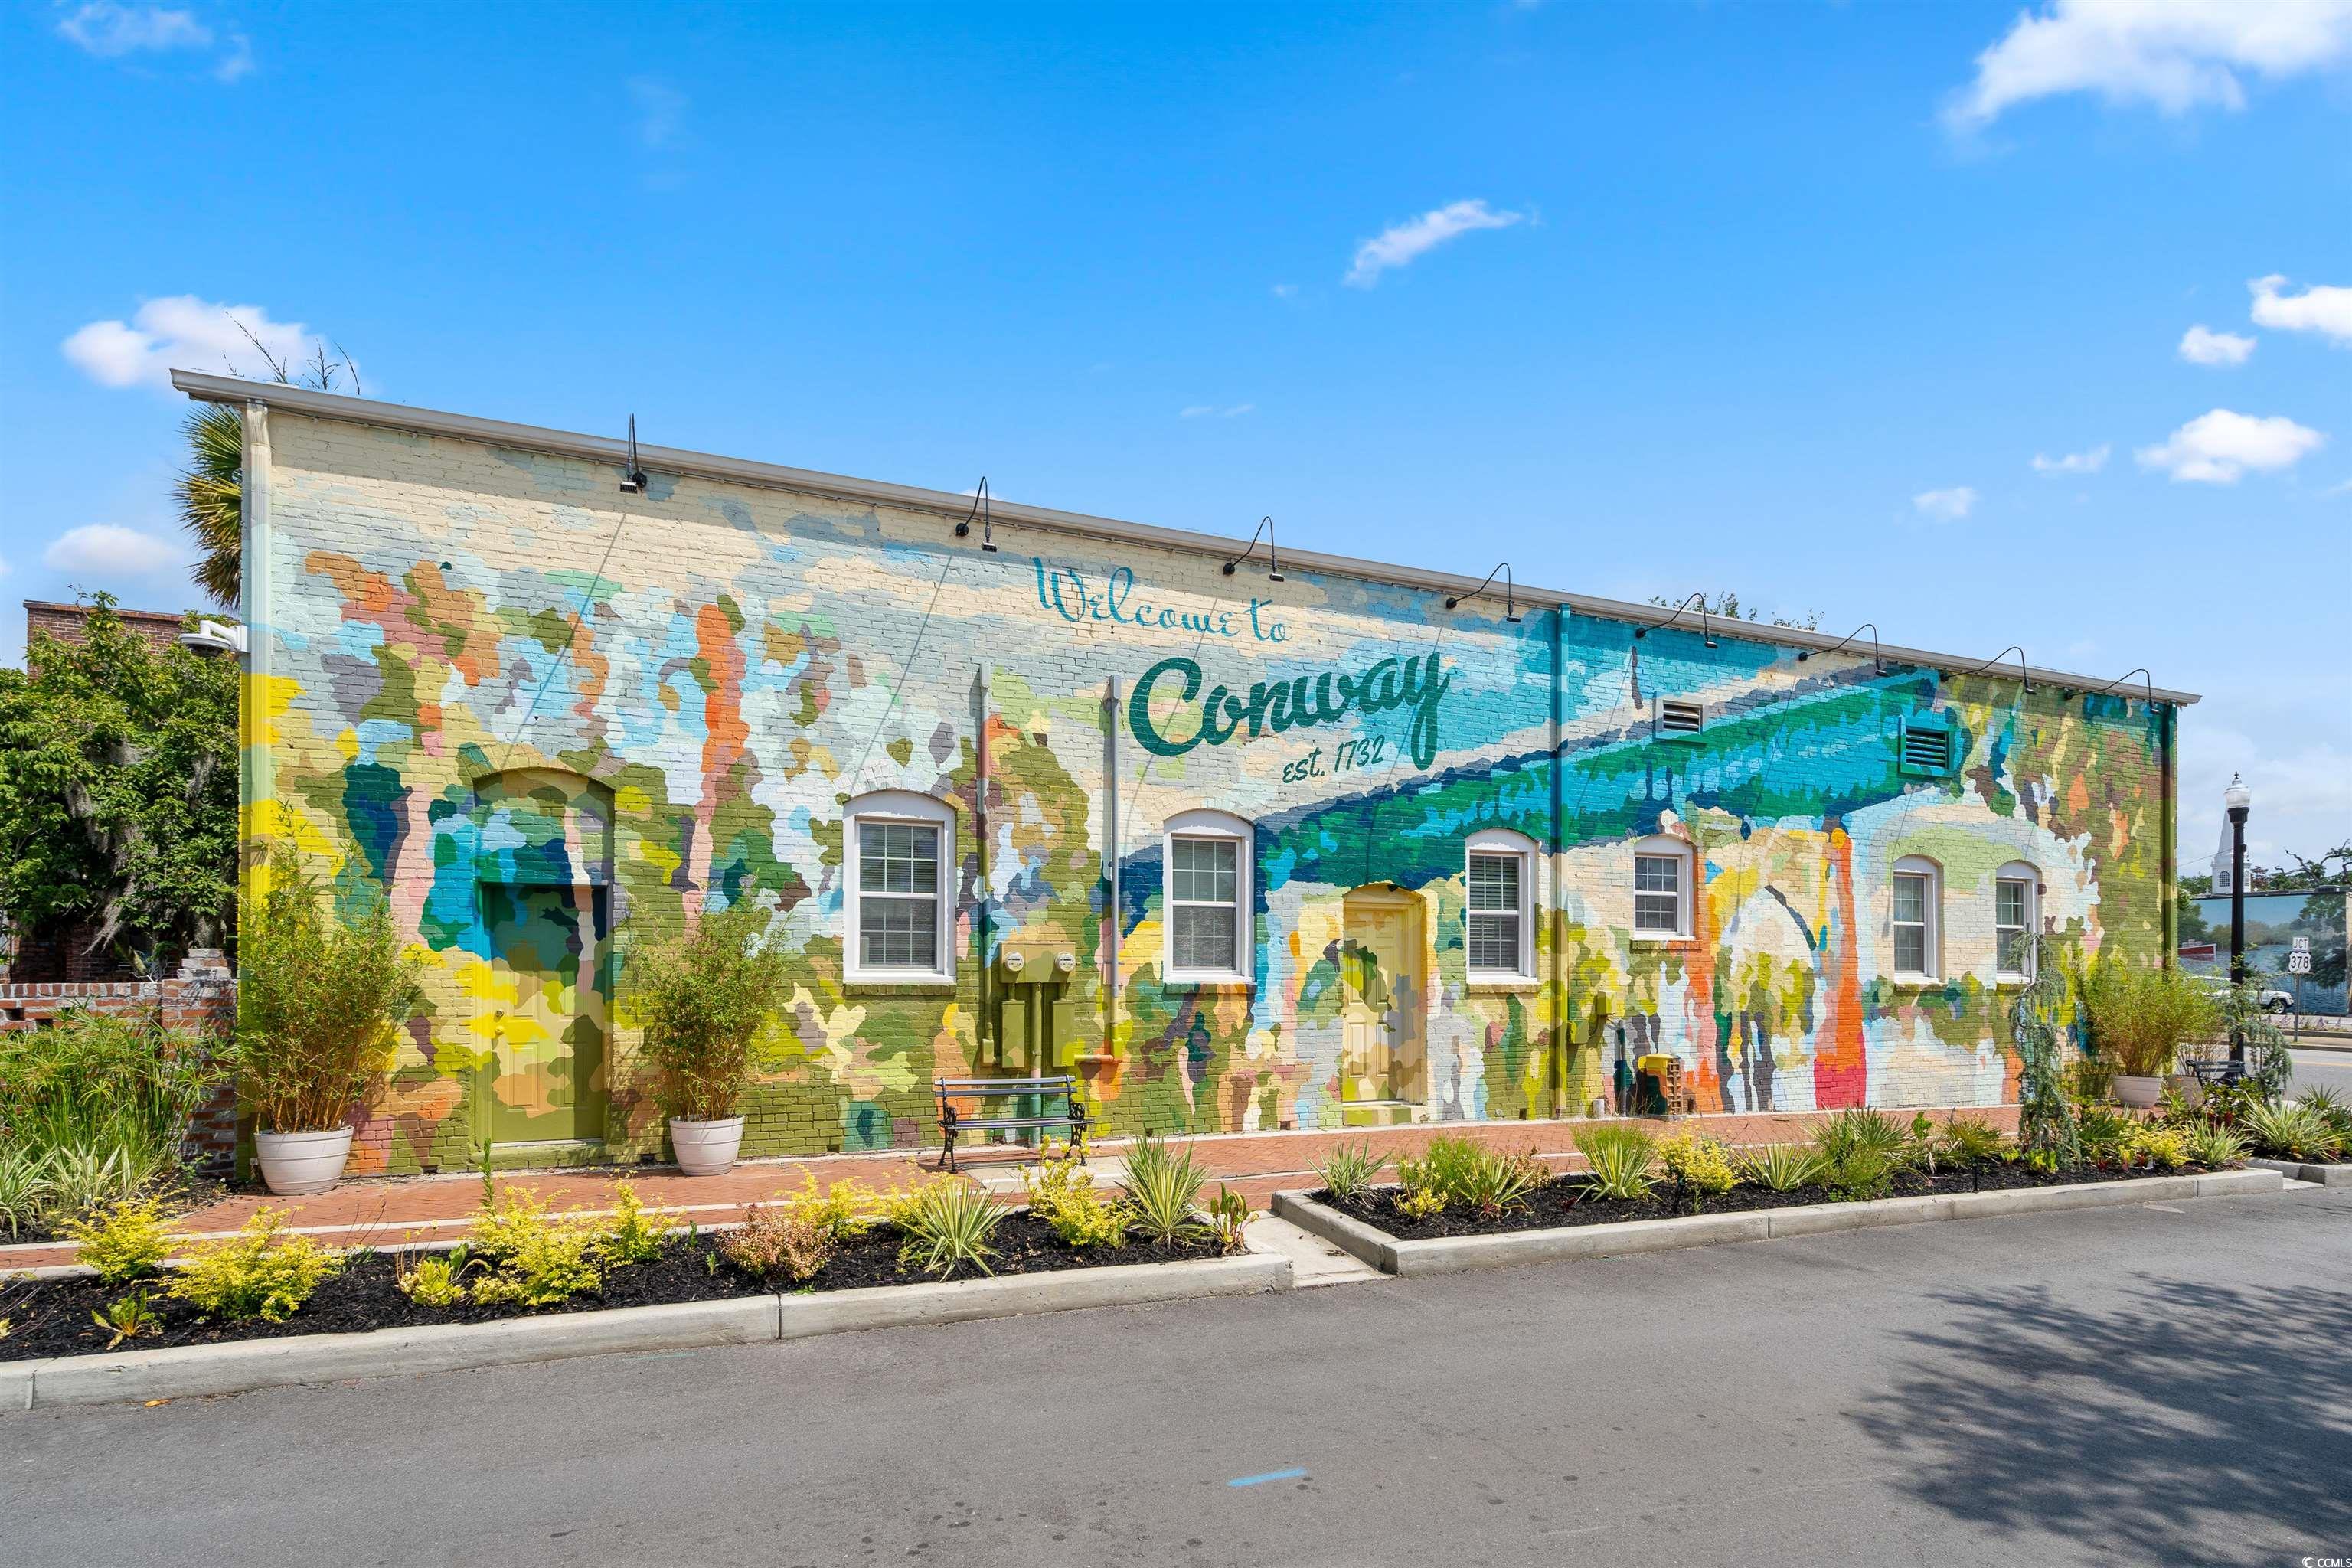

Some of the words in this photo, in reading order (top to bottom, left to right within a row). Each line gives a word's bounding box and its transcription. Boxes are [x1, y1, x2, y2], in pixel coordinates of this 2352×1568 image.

[1033, 557, 1240, 637] Welcome
[1243, 597, 1293, 643] to
[1129, 651, 1450, 771] Conway
[1282, 747, 1325, 783] est.
[1334, 734, 1386, 773] 1732
[2290, 956, 2309, 969] 378
[2293, 939, 2308, 949] JCT
